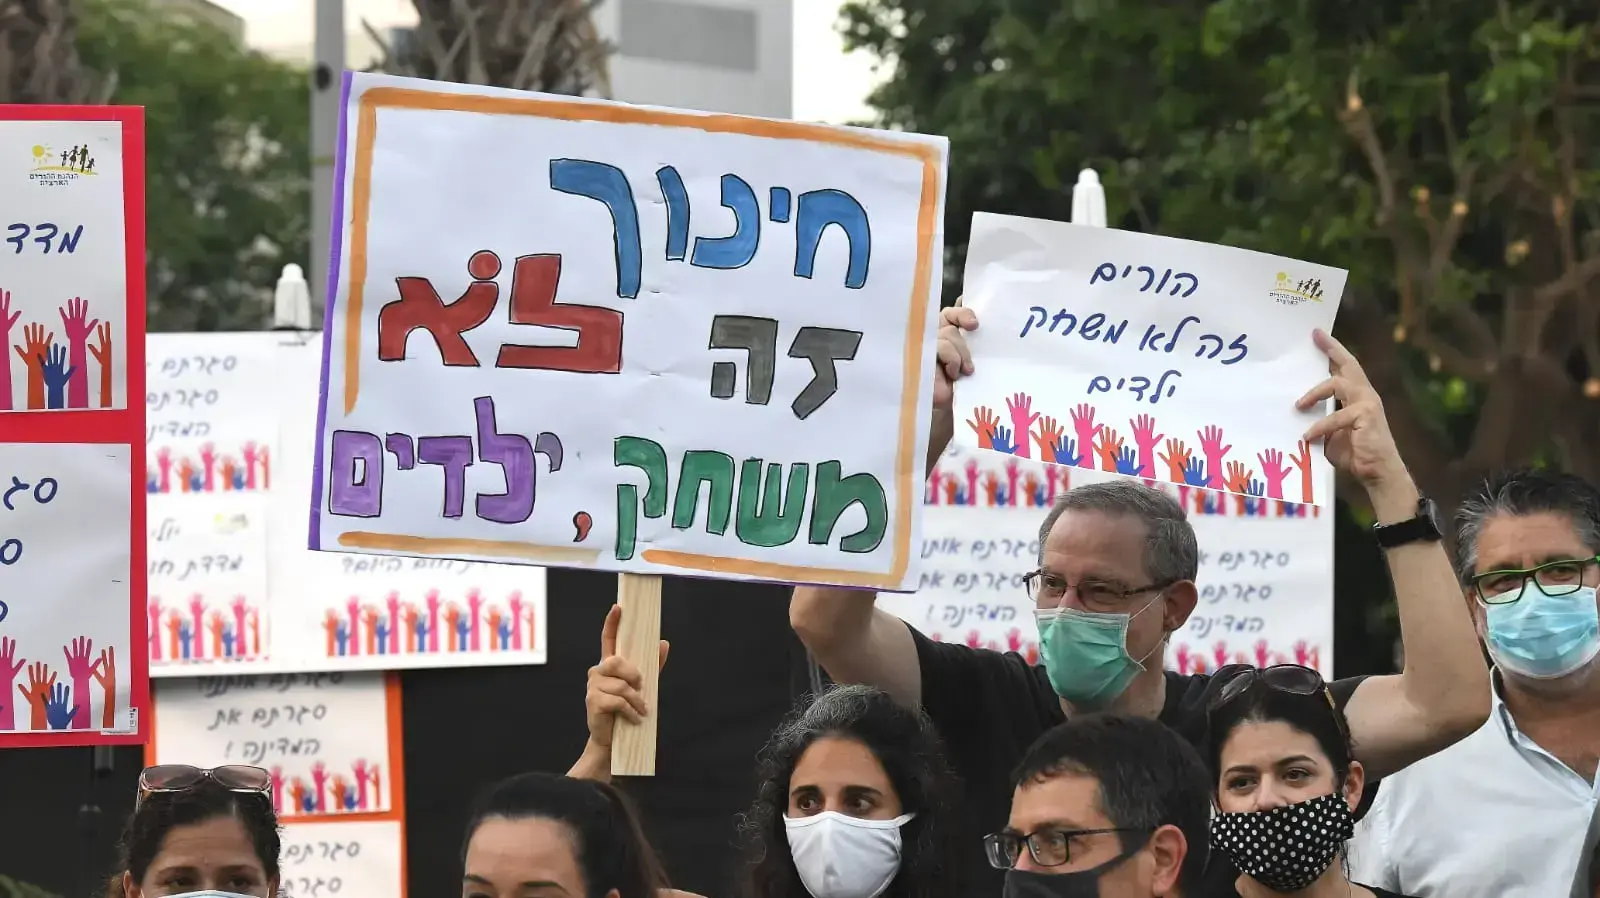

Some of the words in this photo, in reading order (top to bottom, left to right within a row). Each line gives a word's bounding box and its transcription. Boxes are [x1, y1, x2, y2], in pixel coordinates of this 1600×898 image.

[550, 157, 871, 299] חינוך
[1090, 261, 1199, 298] הורים
[1020, 306, 1128, 344] משחק
[1138, 315, 1200, 353] לא
[1196, 333, 1249, 365] זה
[709, 313, 863, 420] זה
[1087, 369, 1182, 404] ילדים
[328, 395, 564, 524] ילדים
[971, 538, 1040, 561] סגרתם
[1218, 550, 1290, 571] סגרתם
[952, 572, 1025, 593] סגרתם
[1201, 583, 1272, 605] סגרתם
[942, 603, 1017, 628] המדינה
[1190, 615, 1265, 639] המדינה
[207, 708, 243, 731] את
[252, 704, 327, 728] סגרתם
[243, 737, 321, 764] המדינה
[284, 841, 361, 864] סגרתם
